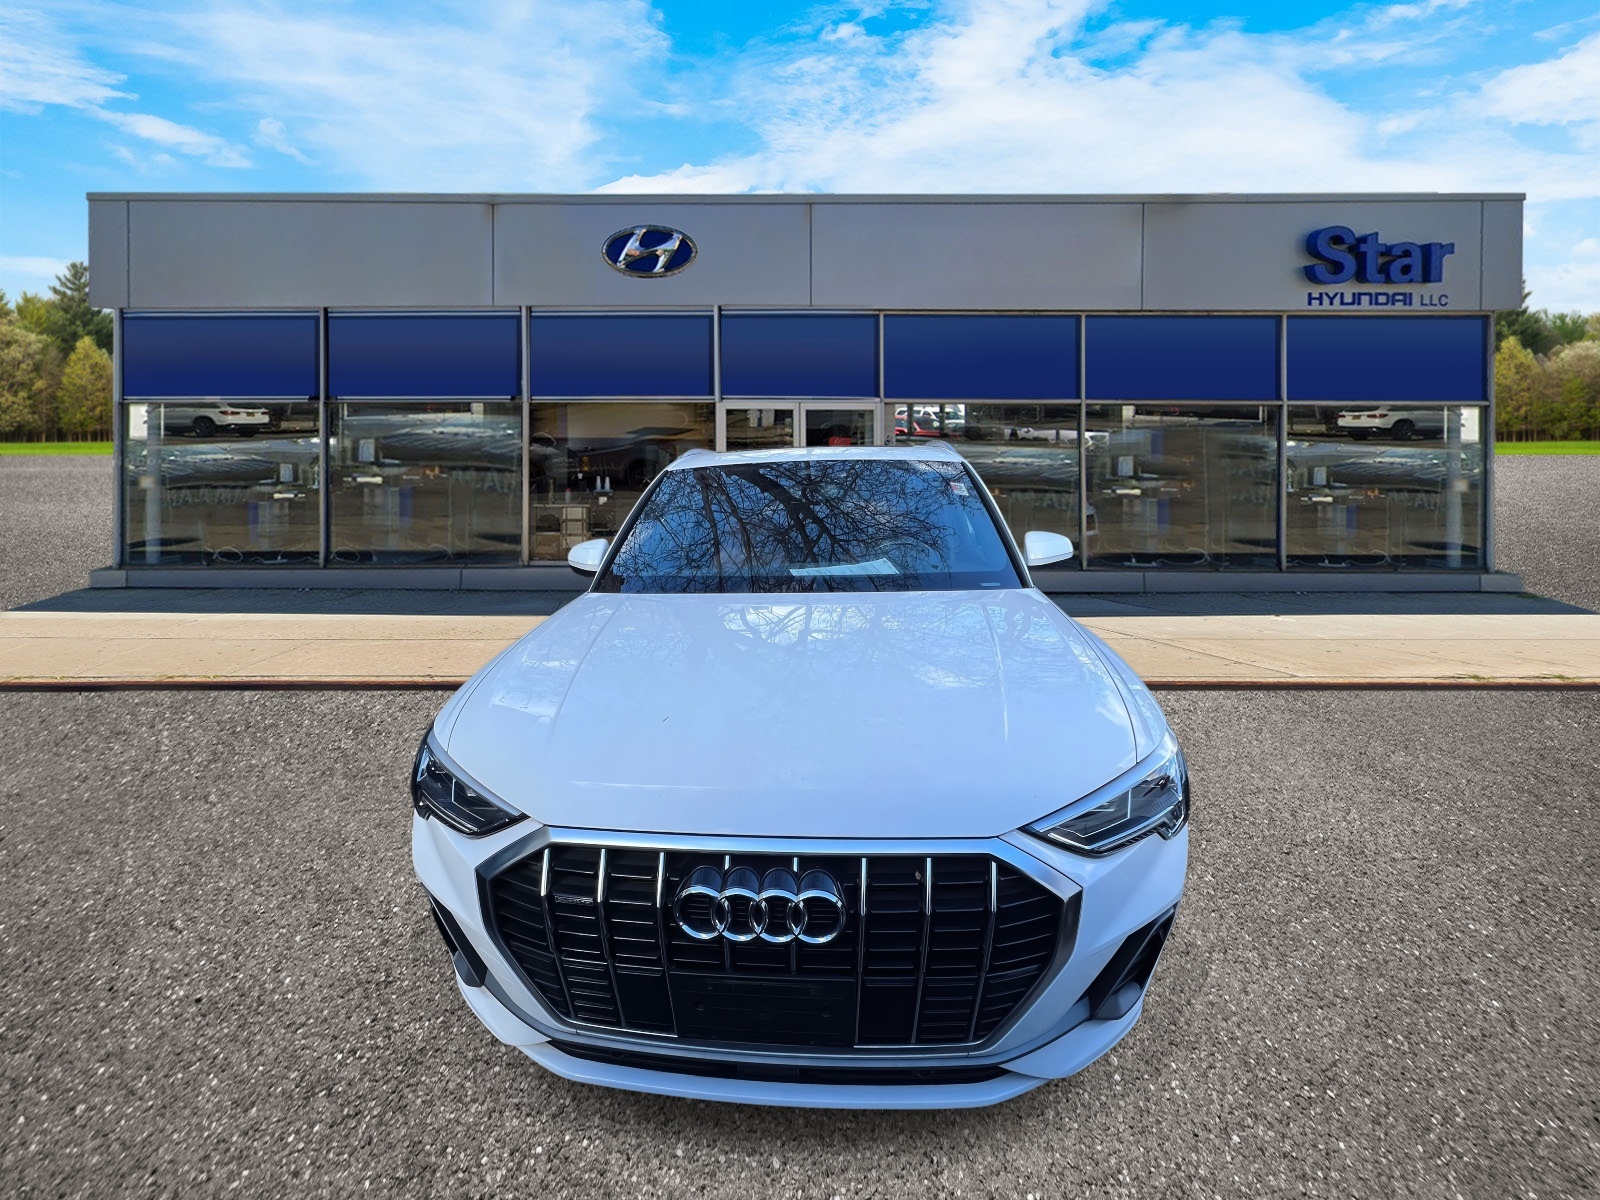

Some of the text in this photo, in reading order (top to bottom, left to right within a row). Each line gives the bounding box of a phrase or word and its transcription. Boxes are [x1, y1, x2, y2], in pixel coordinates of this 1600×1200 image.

[1304, 225, 1455, 284] Star
[1307, 291, 1449, 307] HYUNDAI LLC
